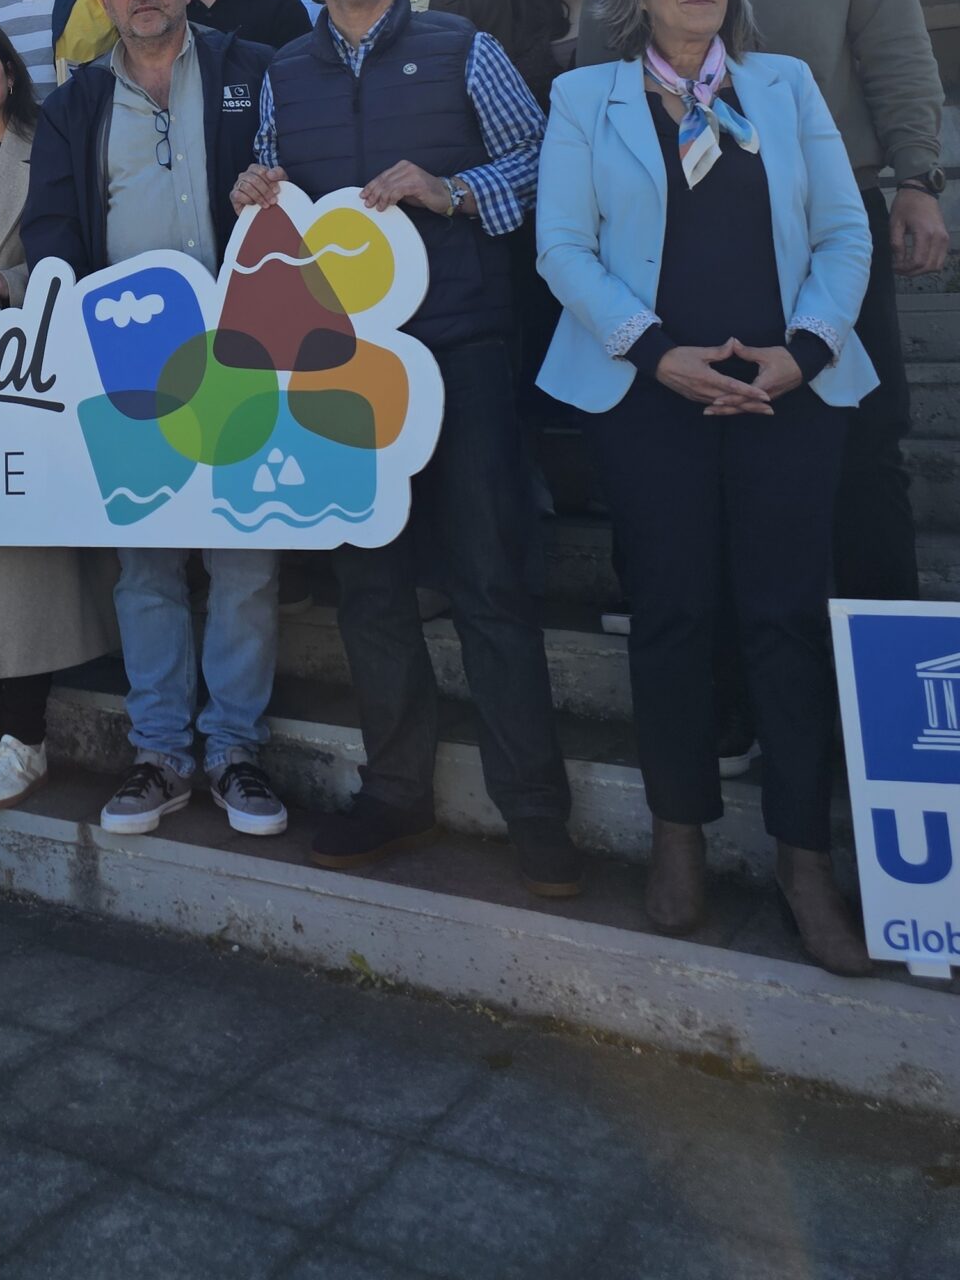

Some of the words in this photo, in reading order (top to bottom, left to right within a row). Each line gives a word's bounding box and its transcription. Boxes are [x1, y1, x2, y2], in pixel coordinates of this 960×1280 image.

[223, 100, 252, 108] nesco
[870, 807, 954, 885] U
[882, 918, 960, 956] Glob
